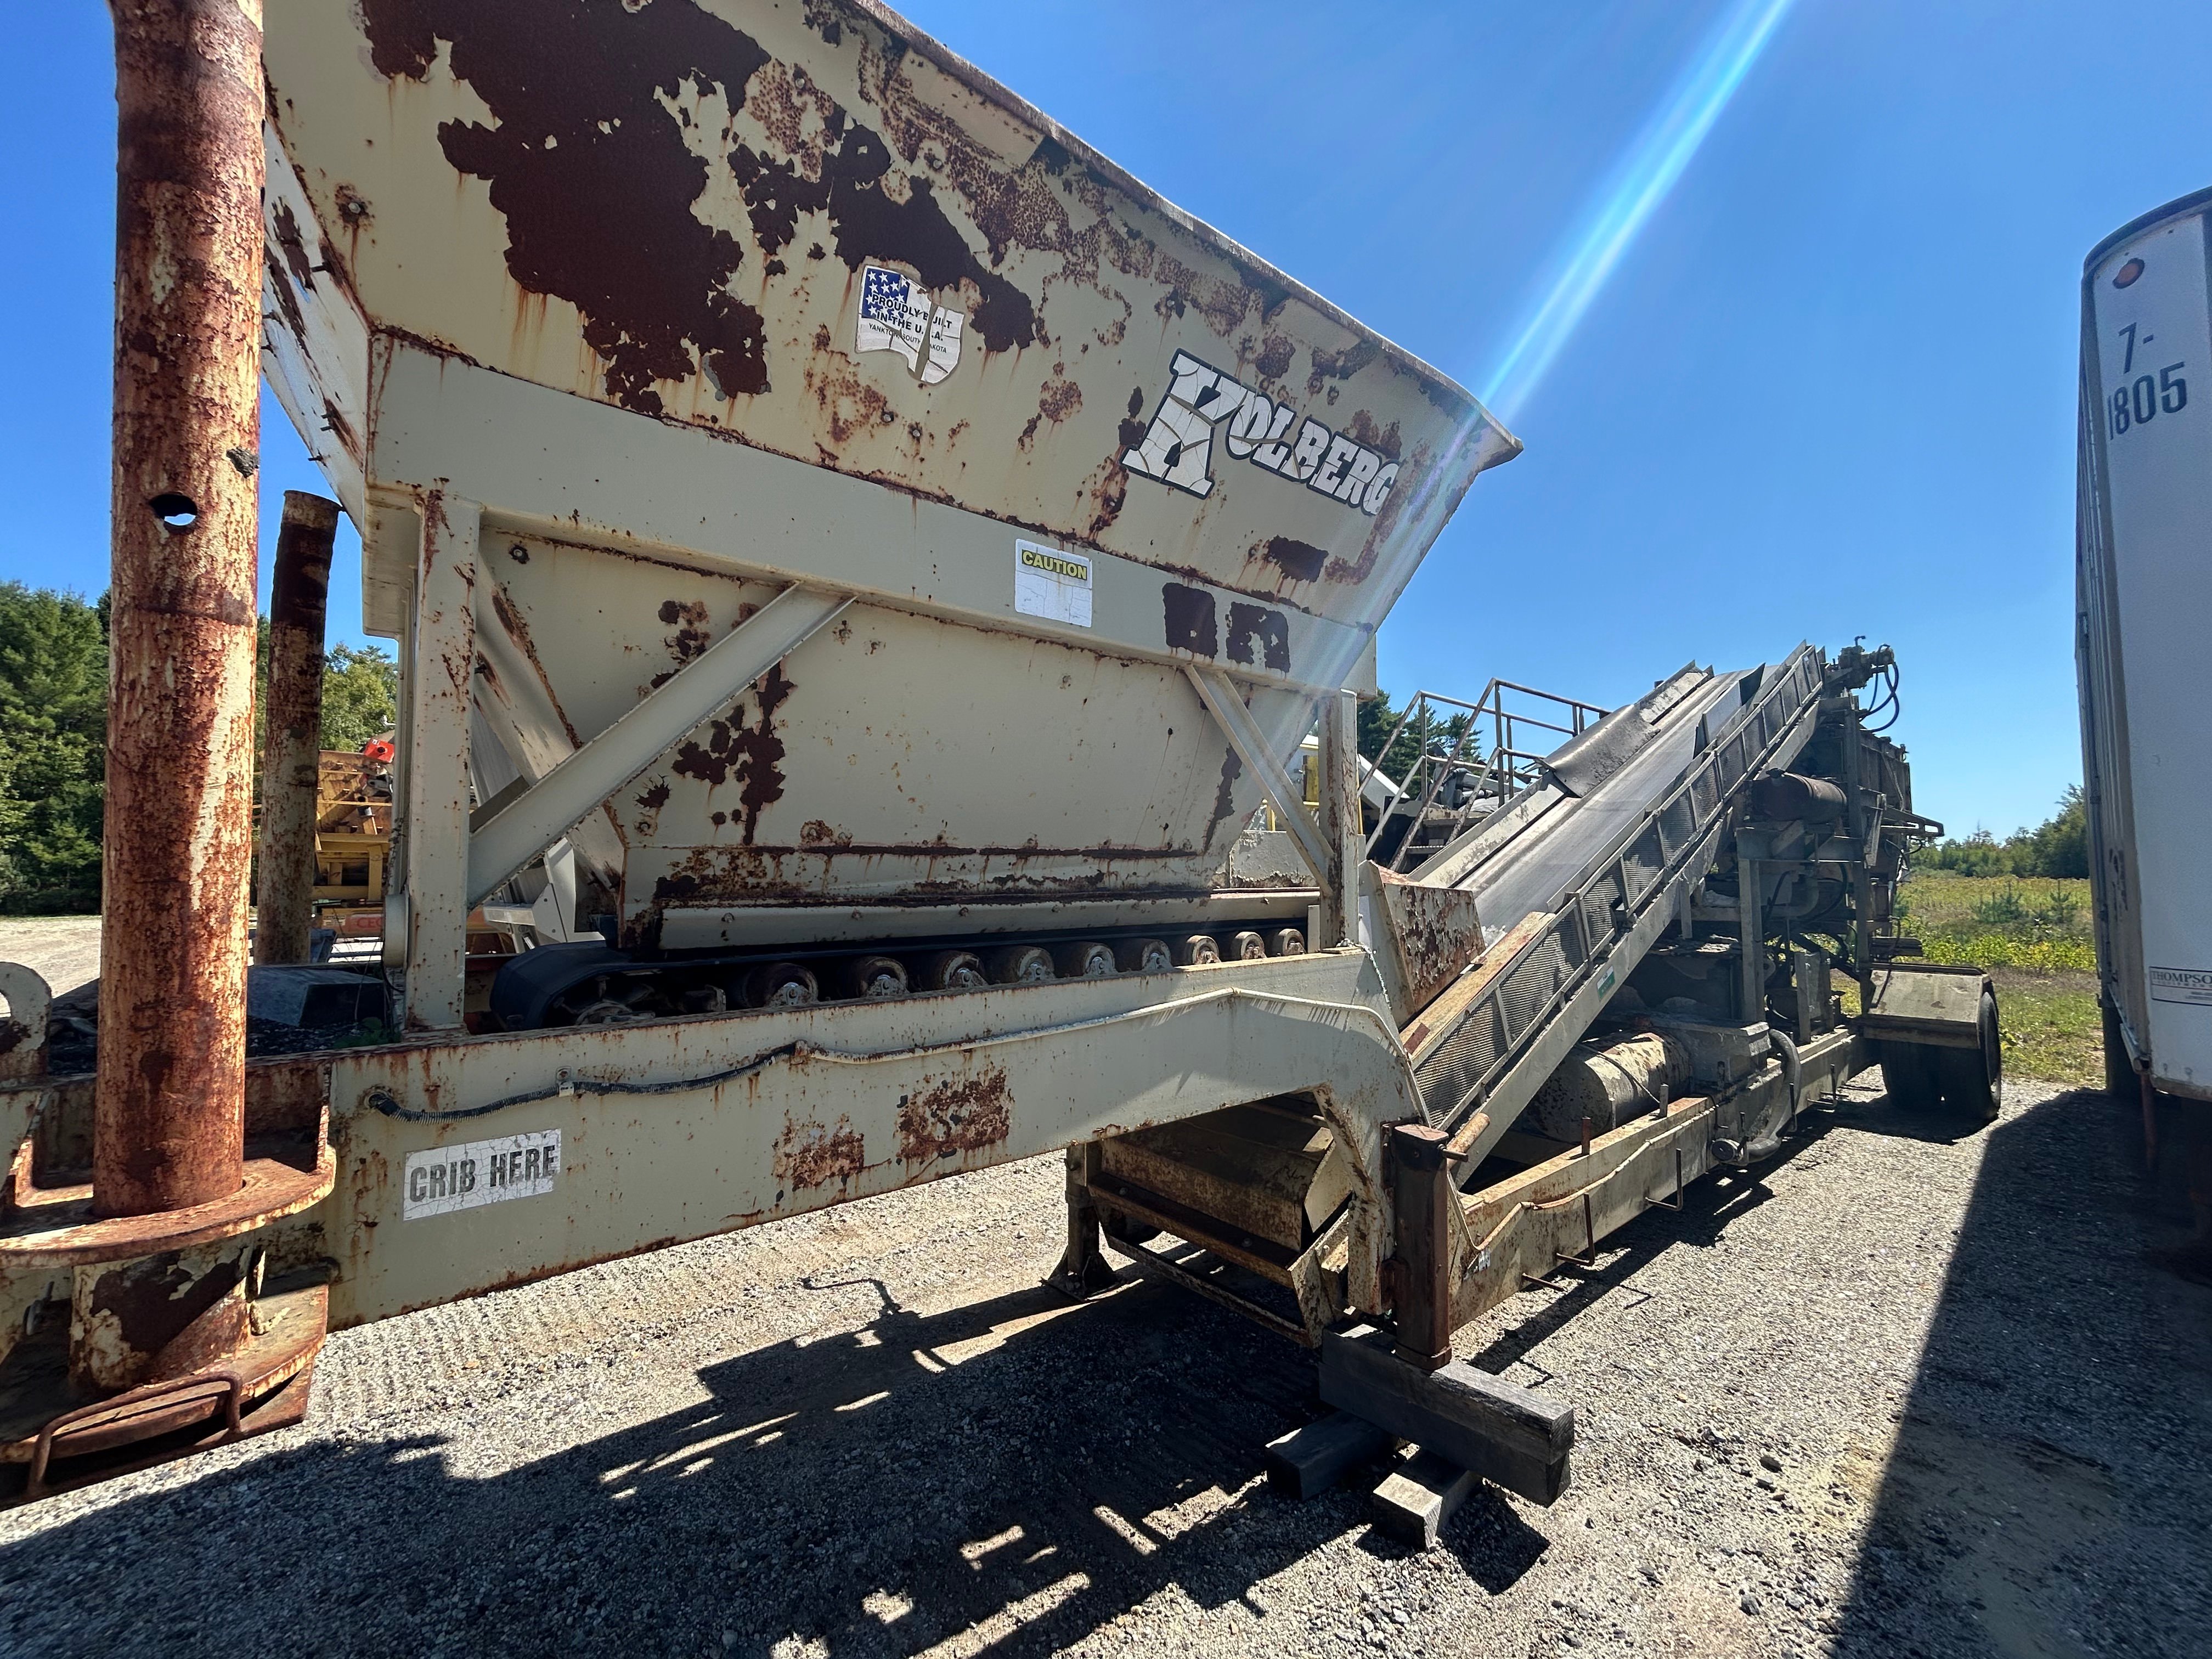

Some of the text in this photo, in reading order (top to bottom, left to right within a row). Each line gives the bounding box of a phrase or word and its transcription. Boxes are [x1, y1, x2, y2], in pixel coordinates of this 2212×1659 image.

[872, 295, 921, 318] PROUDLY
[877, 311, 943, 341] IN THE U..A.
[930, 343, 947, 353] KOTA
[2118, 322, 2154, 375] 7-
[1119, 348, 1400, 516] KOLBERG
[1022, 551, 1087, 580] CAUTION
[409, 1144, 555, 1202] CRIB HERE
